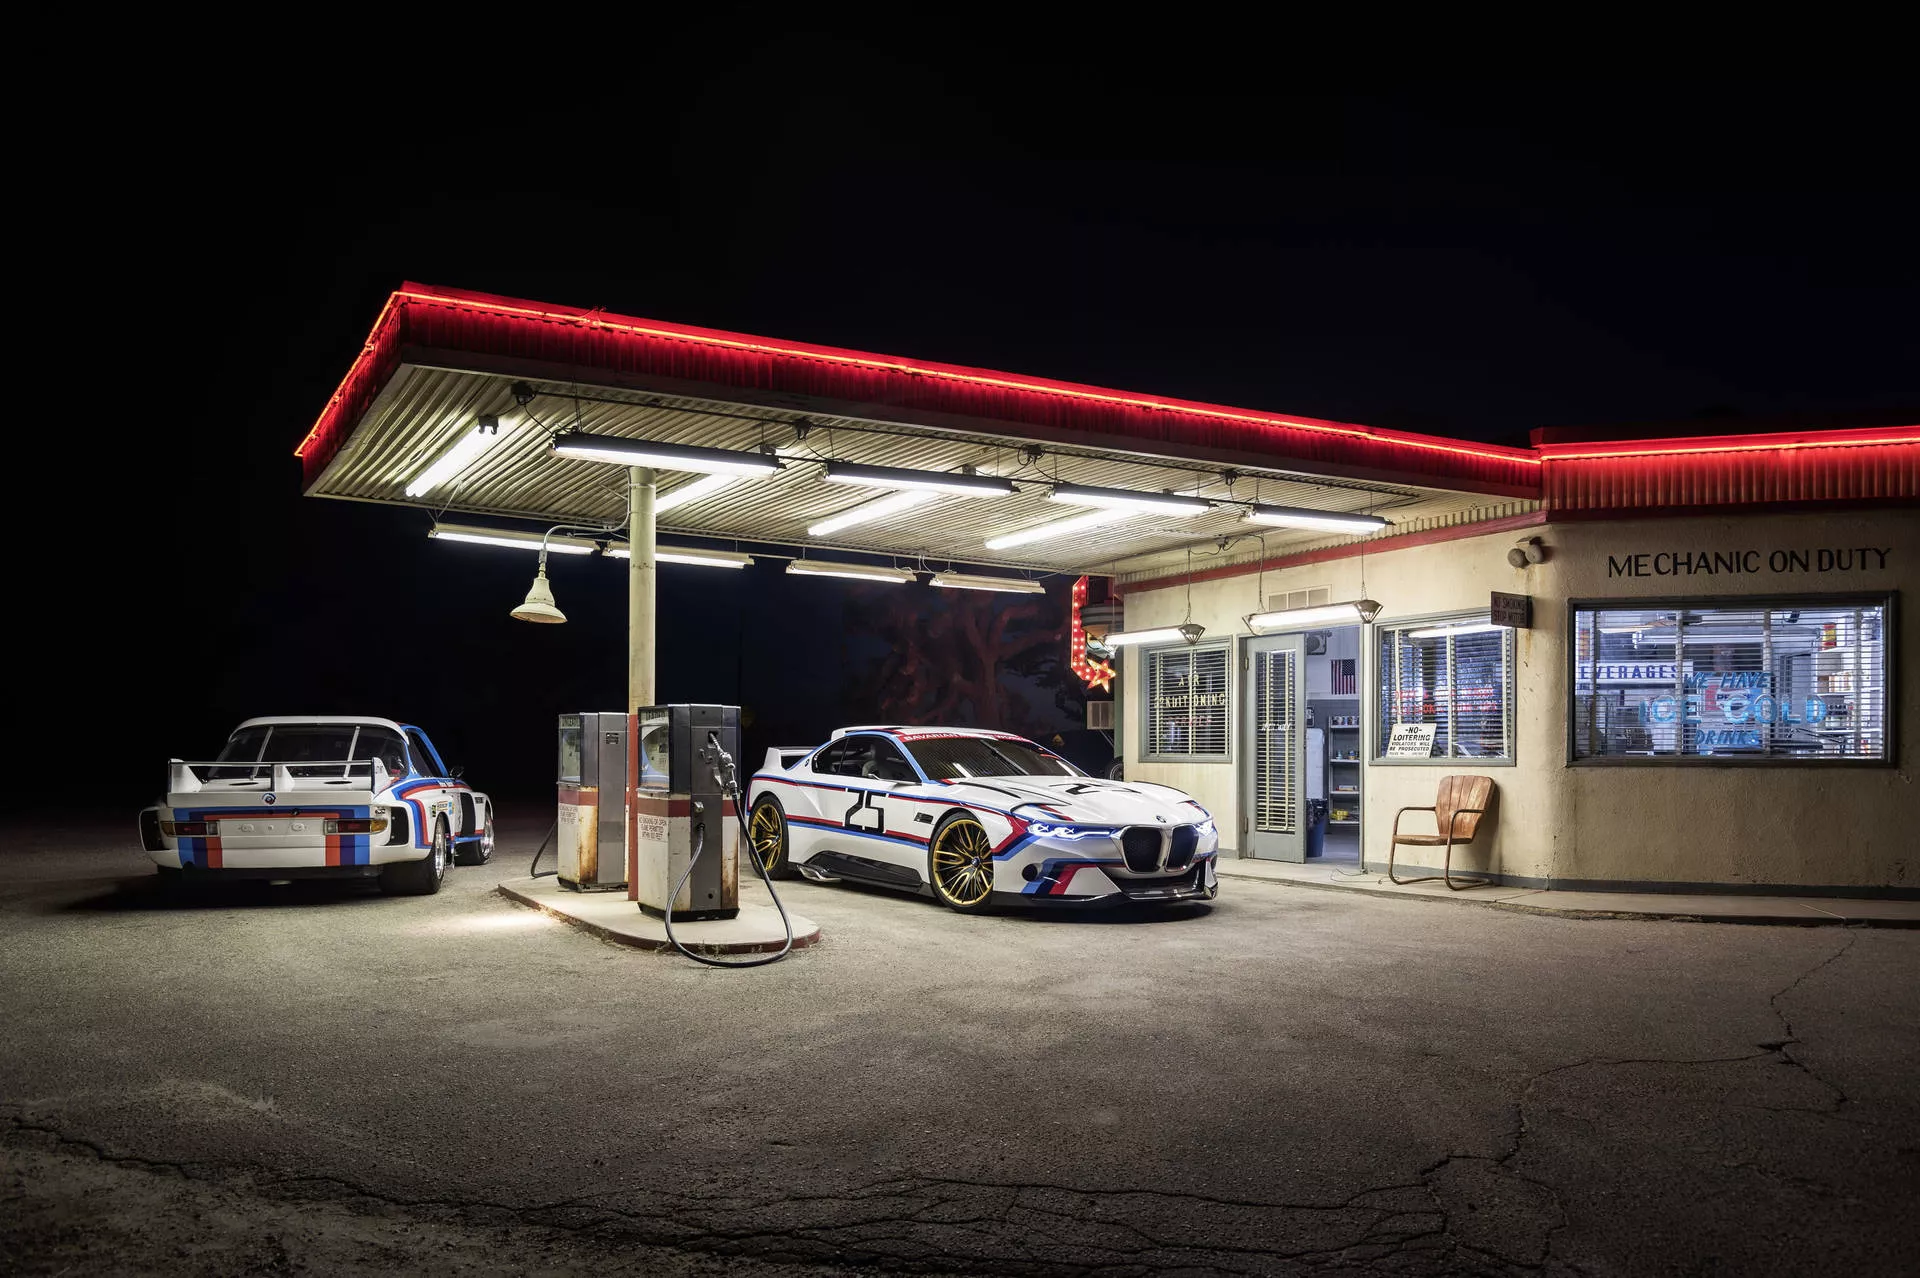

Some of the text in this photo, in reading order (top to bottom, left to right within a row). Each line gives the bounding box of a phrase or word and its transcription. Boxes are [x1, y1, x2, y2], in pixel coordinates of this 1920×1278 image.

[1608, 547, 1892, 578] MECHANIC ON DUTY
[1720, 671, 1772, 689] HAVE
[1154, 694, 1226, 709] CONDITONING
[1638, 694, 1702, 725] ICE
[1723, 693, 1828, 725] COLD
[1694, 729, 1761, 746] DRINKS
[845, 787, 888, 833] 25
